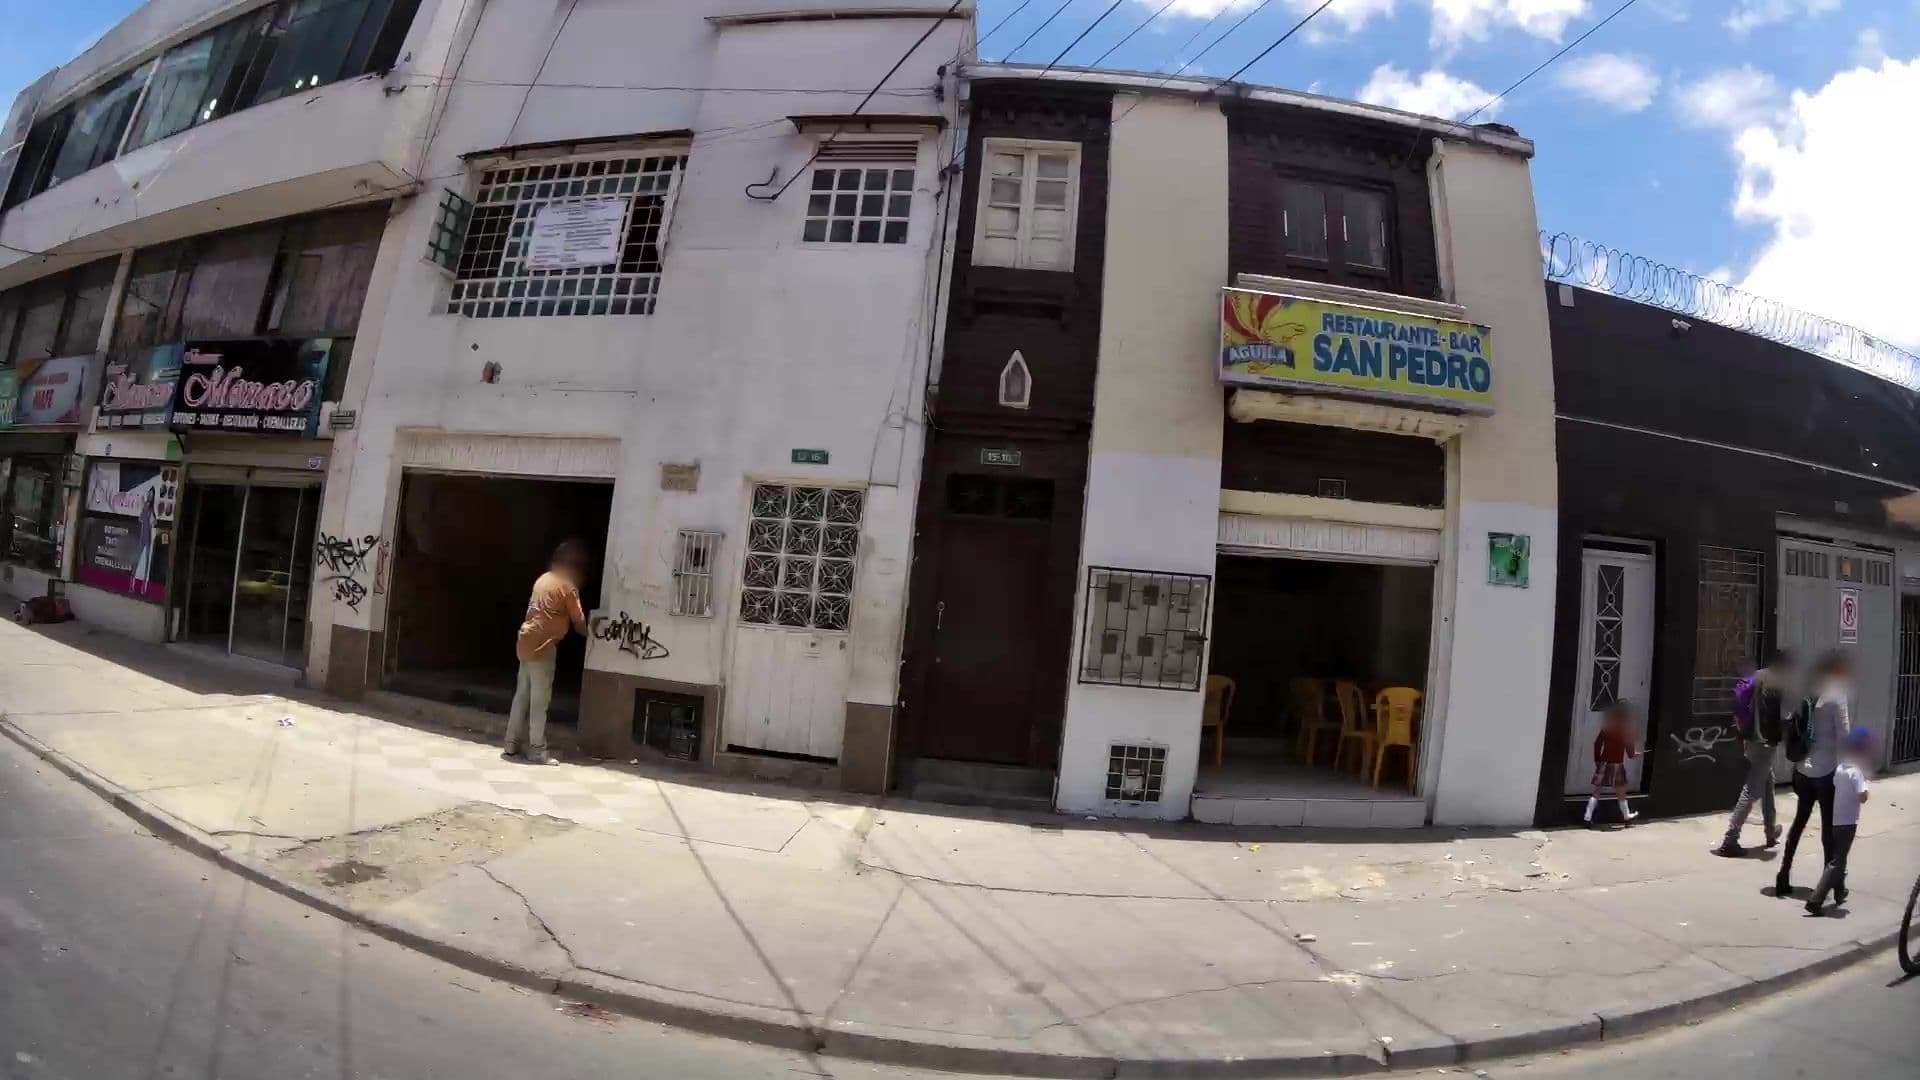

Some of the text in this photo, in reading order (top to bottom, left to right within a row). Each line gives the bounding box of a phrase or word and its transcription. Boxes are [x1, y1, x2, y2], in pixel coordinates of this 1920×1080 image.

[1322, 313, 1440, 346] RESTAURANTE
[1450, 331, 1481, 353] BAR
[1313, 333, 1491, 392] SAN PEDRO
